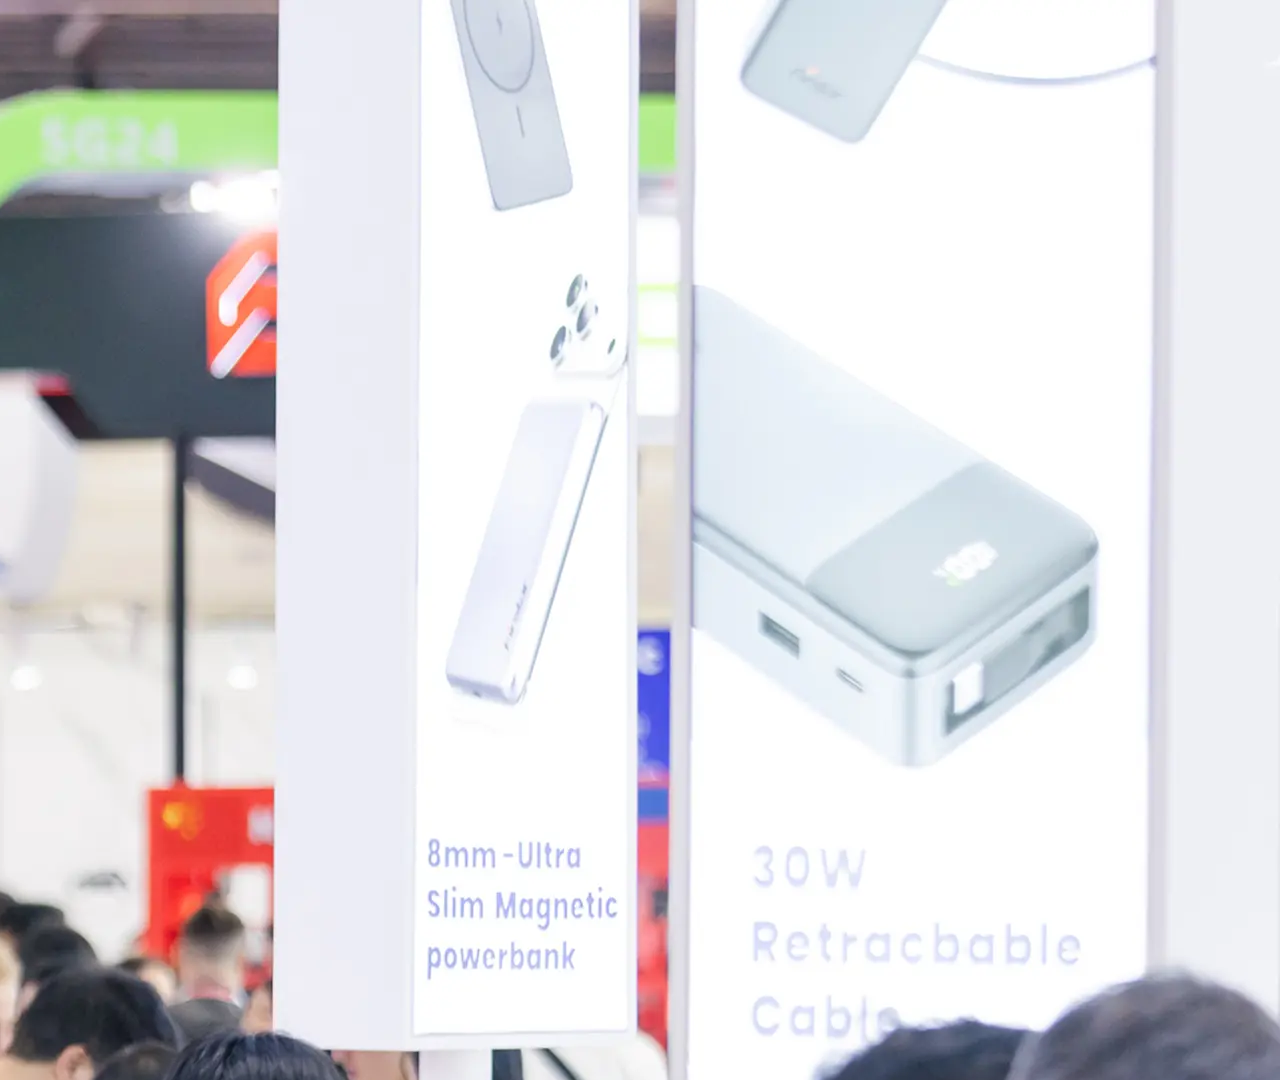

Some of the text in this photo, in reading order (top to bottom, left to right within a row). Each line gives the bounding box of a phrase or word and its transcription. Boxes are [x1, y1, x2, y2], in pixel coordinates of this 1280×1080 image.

[753, 845, 866, 889] 30W
[428, 886, 618, 931] Slim Magnetic
[427, 941, 576, 981] powerbank
[753, 921, 1082, 966] Retracbable
